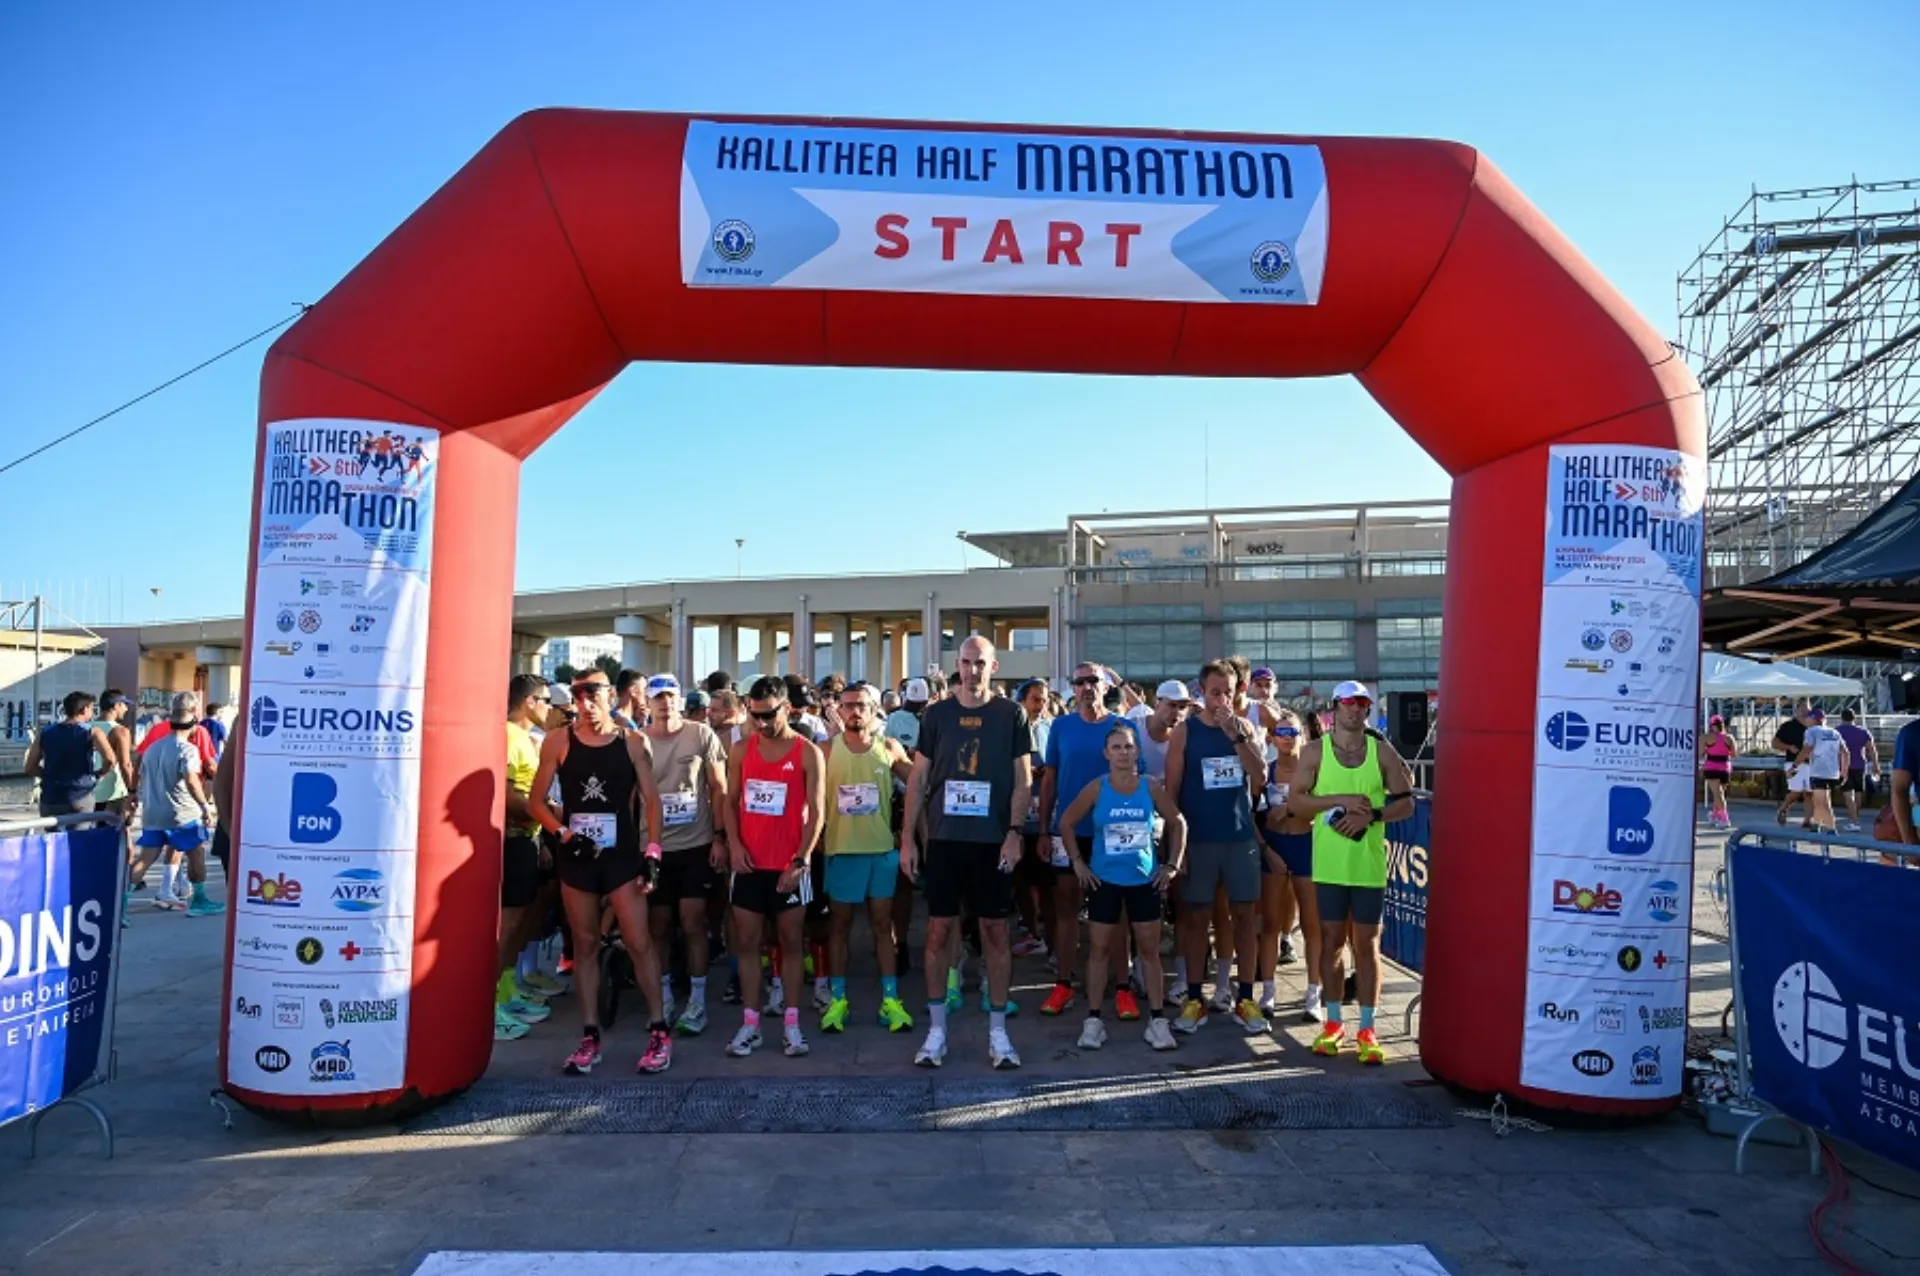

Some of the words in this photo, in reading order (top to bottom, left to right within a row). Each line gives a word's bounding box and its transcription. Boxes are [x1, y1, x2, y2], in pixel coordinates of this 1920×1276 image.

[717, 135, 898, 178] KALLITHEA
[916, 144, 998, 182] HALF
[1016, 142, 1294, 199] MARATHON
[873, 213, 1143, 268] START
[273, 429, 362, 456] KALLITHEA
[271, 454, 307, 479] HALF
[1564, 455, 1665, 481] KALLITHEA
[1563, 480, 1612, 503] HALF
[267, 479, 417, 532] MARATHON
[282, 706, 414, 733] EUROINS
[1595, 722, 1694, 751] EUROINS
[665, 803, 688, 815] 234
[854, 795, 863, 806] 5
[955, 792, 977, 804] 164
[297, 815, 332, 831] FON
[1119, 833, 1134, 844] 57
[1616, 827, 1647, 844] FON
[247, 870, 302, 902] Dole
[1553, 879, 1623, 912] Dole
[258, 1051, 288, 1069] MAD
[315, 1059, 347, 1073] MAD
[1576, 1056, 1610, 1072] MAD
